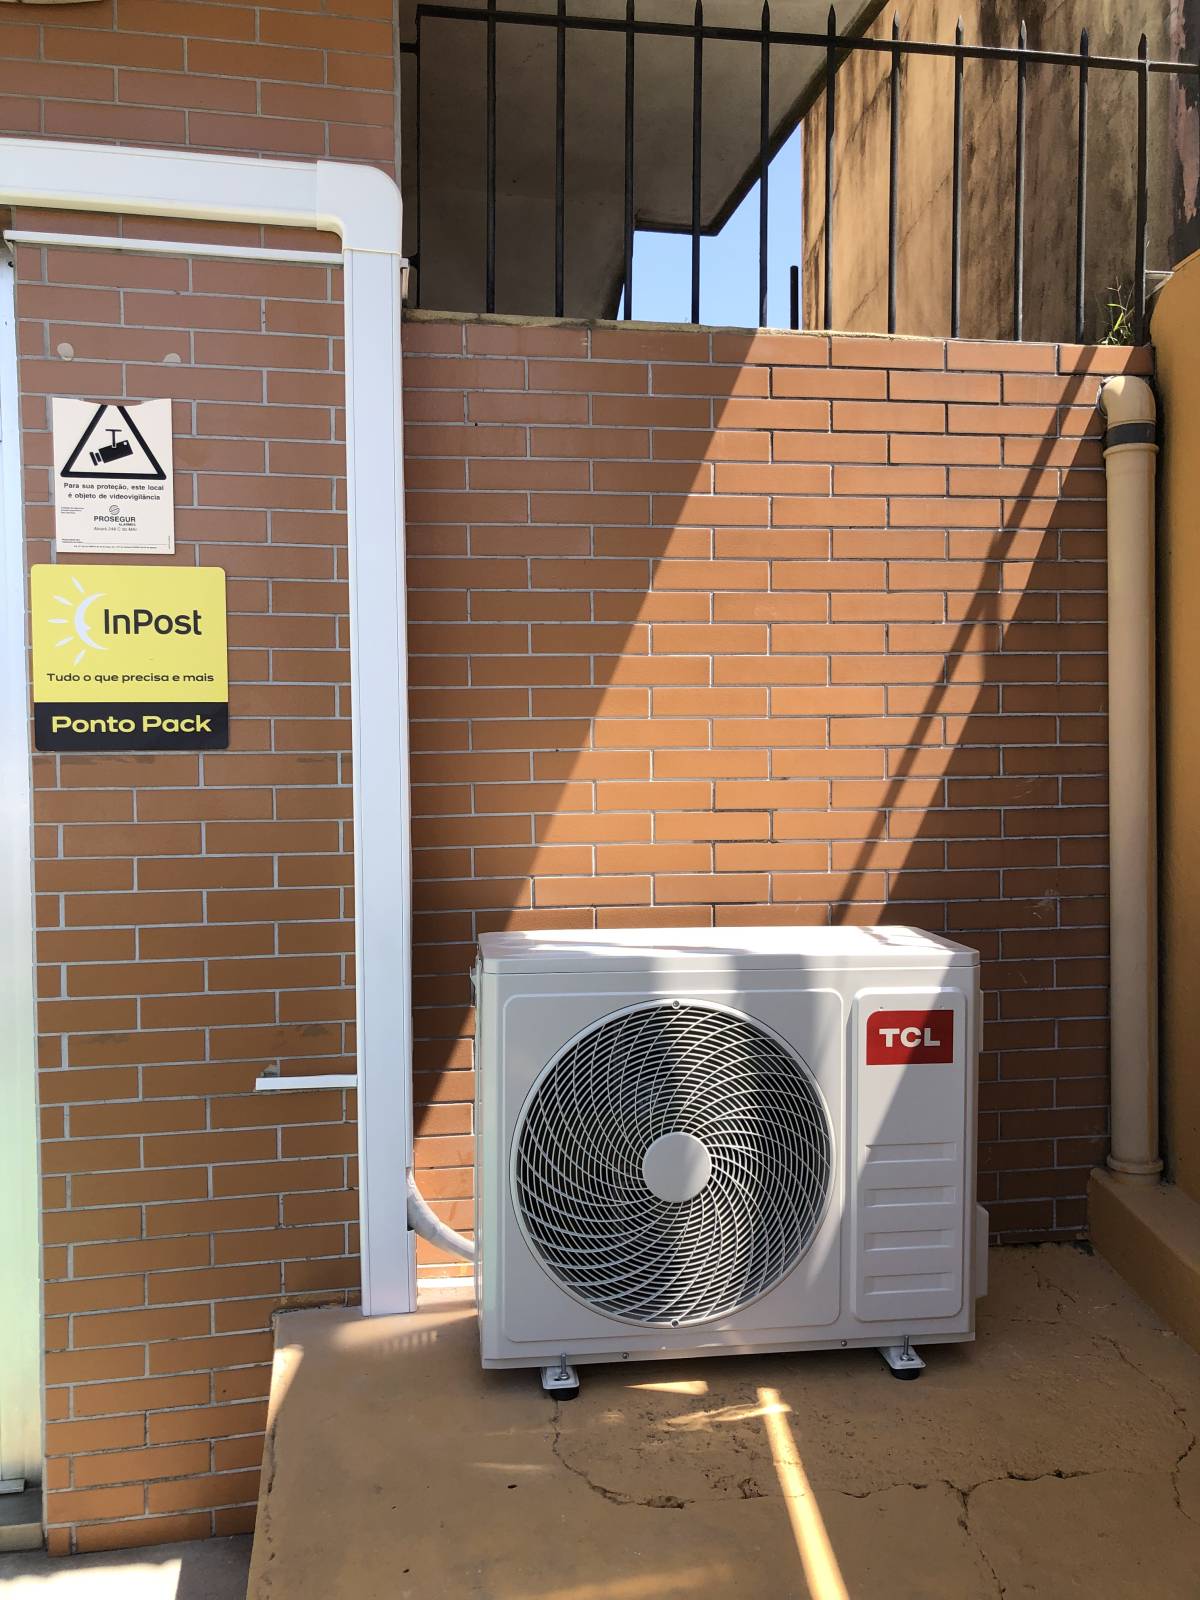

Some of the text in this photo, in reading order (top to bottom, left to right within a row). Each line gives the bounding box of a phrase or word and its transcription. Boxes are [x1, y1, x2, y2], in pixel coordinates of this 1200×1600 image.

[104, 608, 202, 636] InPost
[47, 673, 80, 682] Tudo
[94, 674, 119, 684] que
[122, 673, 169, 684] precisa
[183, 673, 214, 682] mais
[52, 714, 212, 733] Ponto Pack
[879, 1026, 940, 1048] TCL
